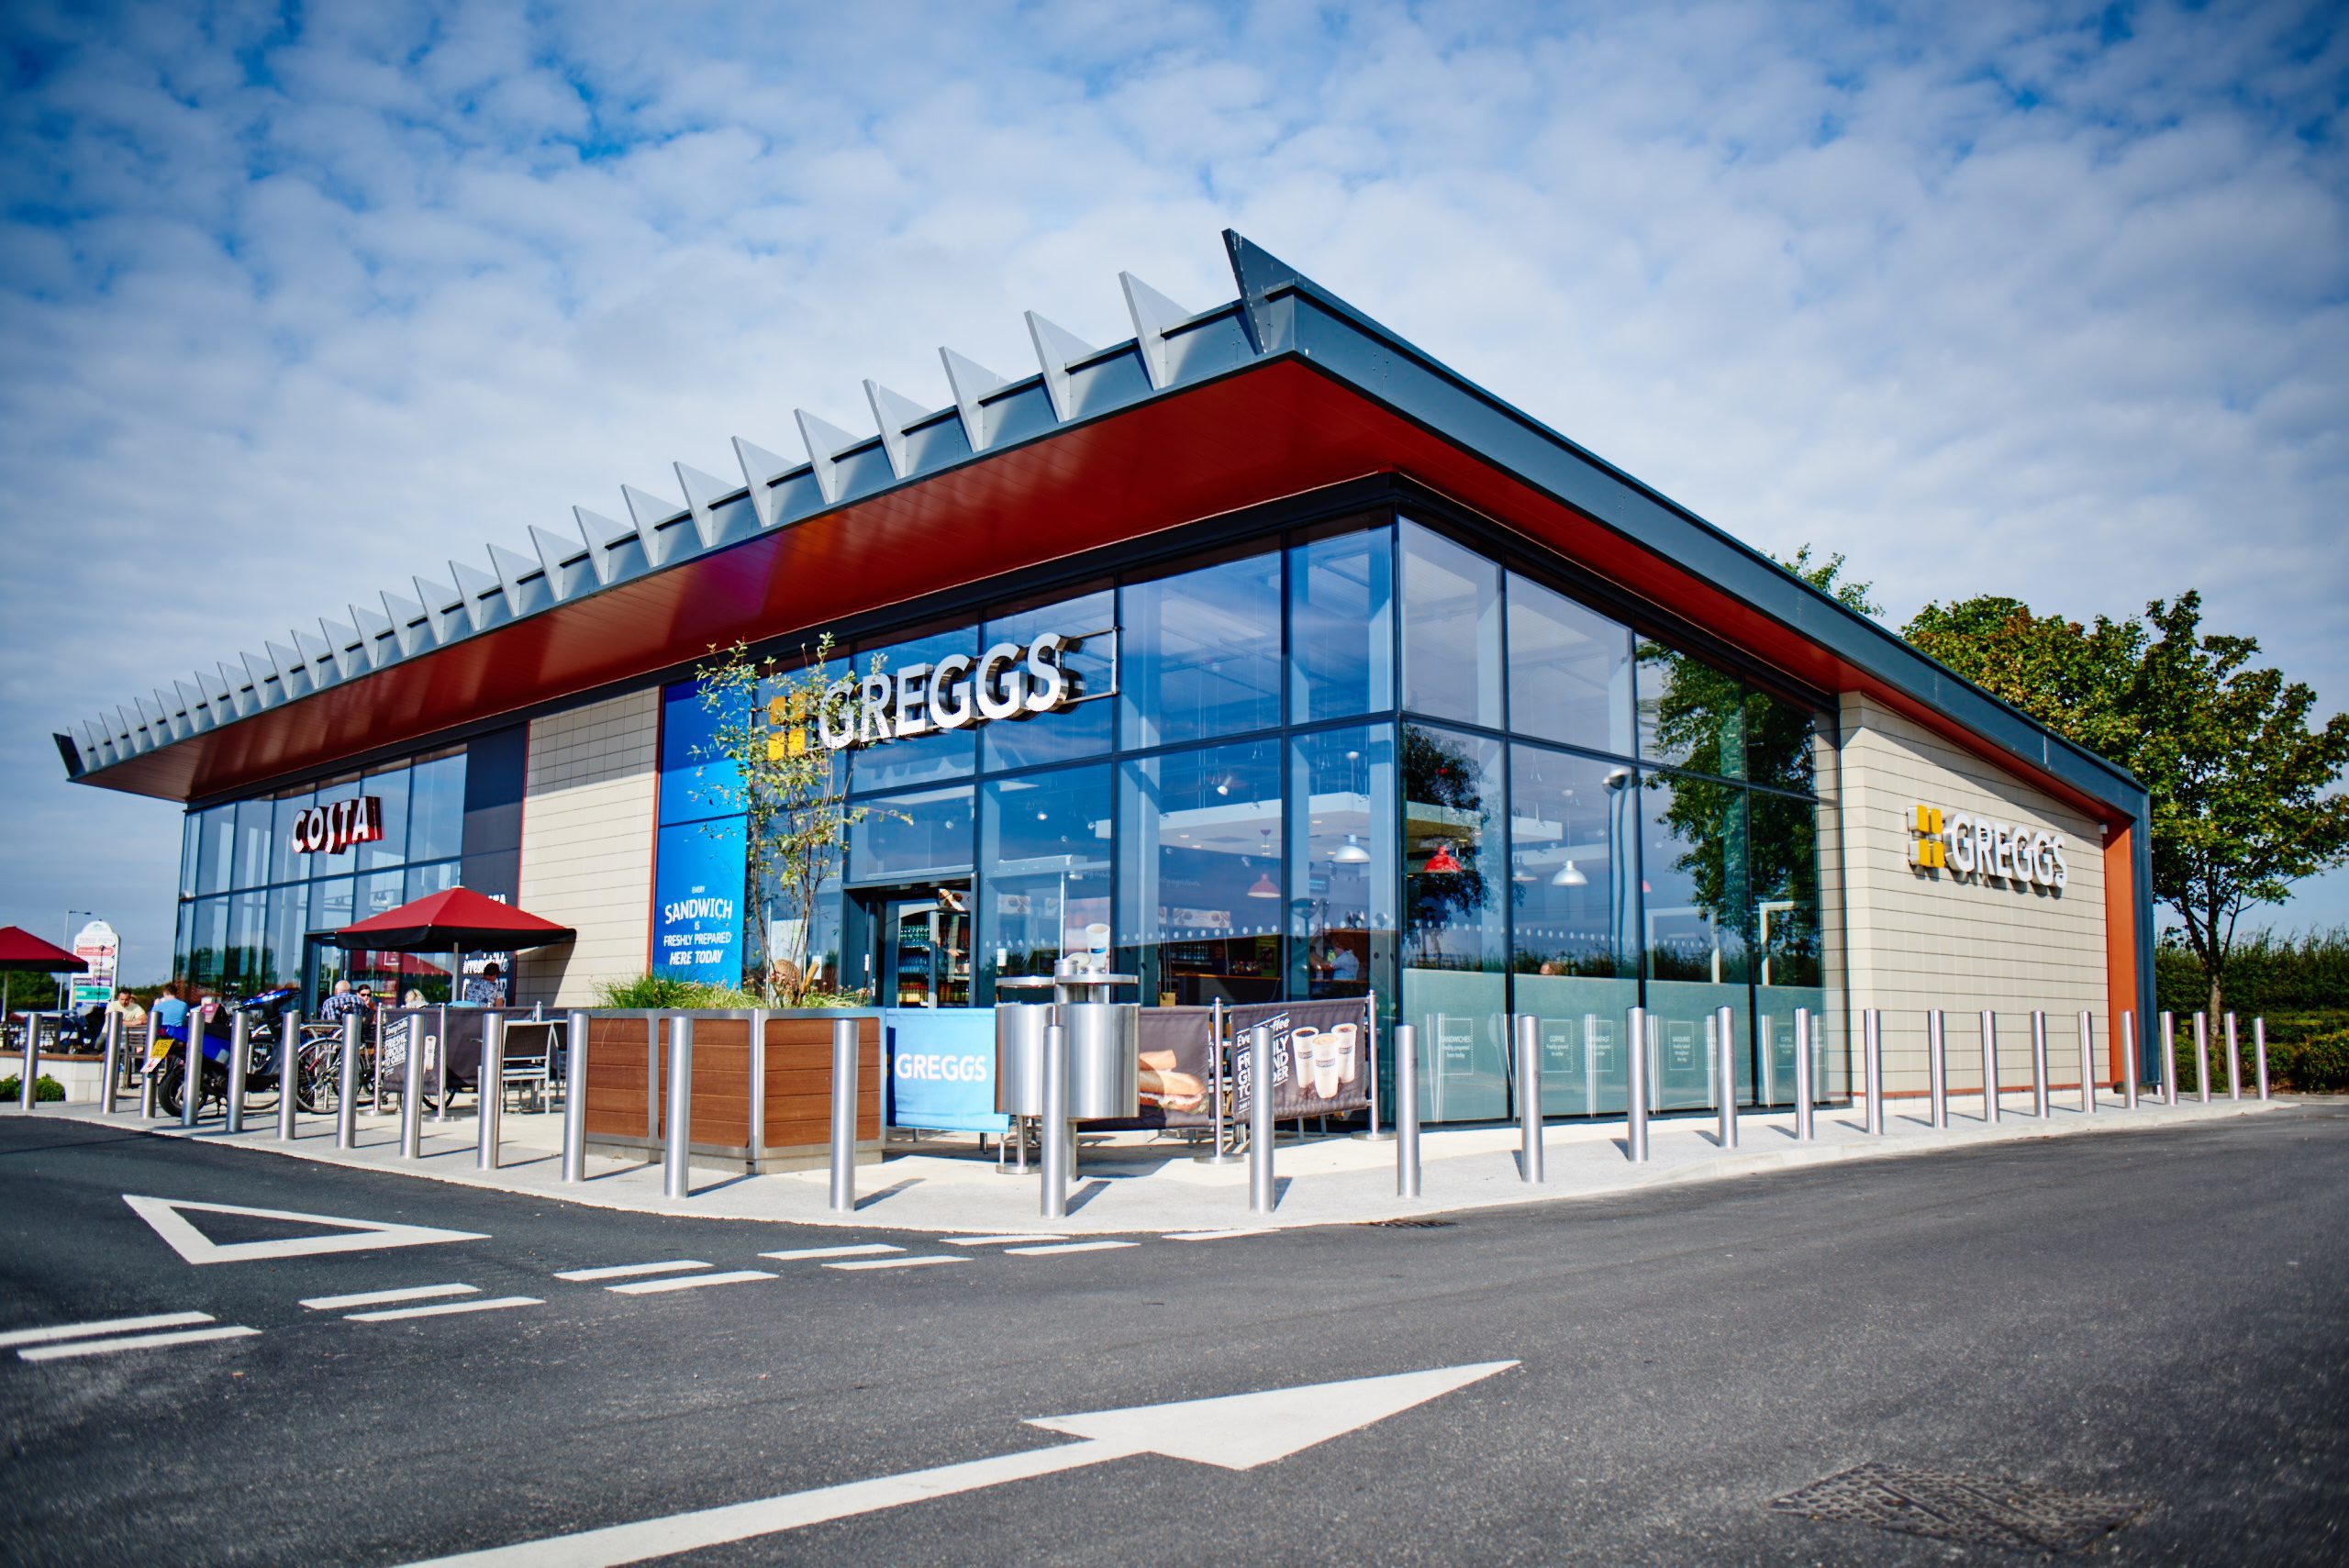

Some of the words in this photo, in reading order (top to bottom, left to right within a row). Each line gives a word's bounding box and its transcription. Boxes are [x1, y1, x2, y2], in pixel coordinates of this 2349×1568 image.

[818, 632, 1064, 750] GREGGS
[292, 795, 375, 854] COSTA
[1951, 812, 2068, 889] GREGGS
[664, 897, 733, 925] SANDWICH
[663, 934, 693, 947] FRESHLY
[695, 931, 732, 945] PREPARED
[670, 951, 693, 965] HERE
[695, 950, 723, 963] TODAY
[1237, 1033, 1250, 1048] Eve
[1271, 1018, 1290, 1032] ffee
[1440, 1035, 1471, 1043] SANDWICHES
[895, 1052, 987, 1082] GREGGS
